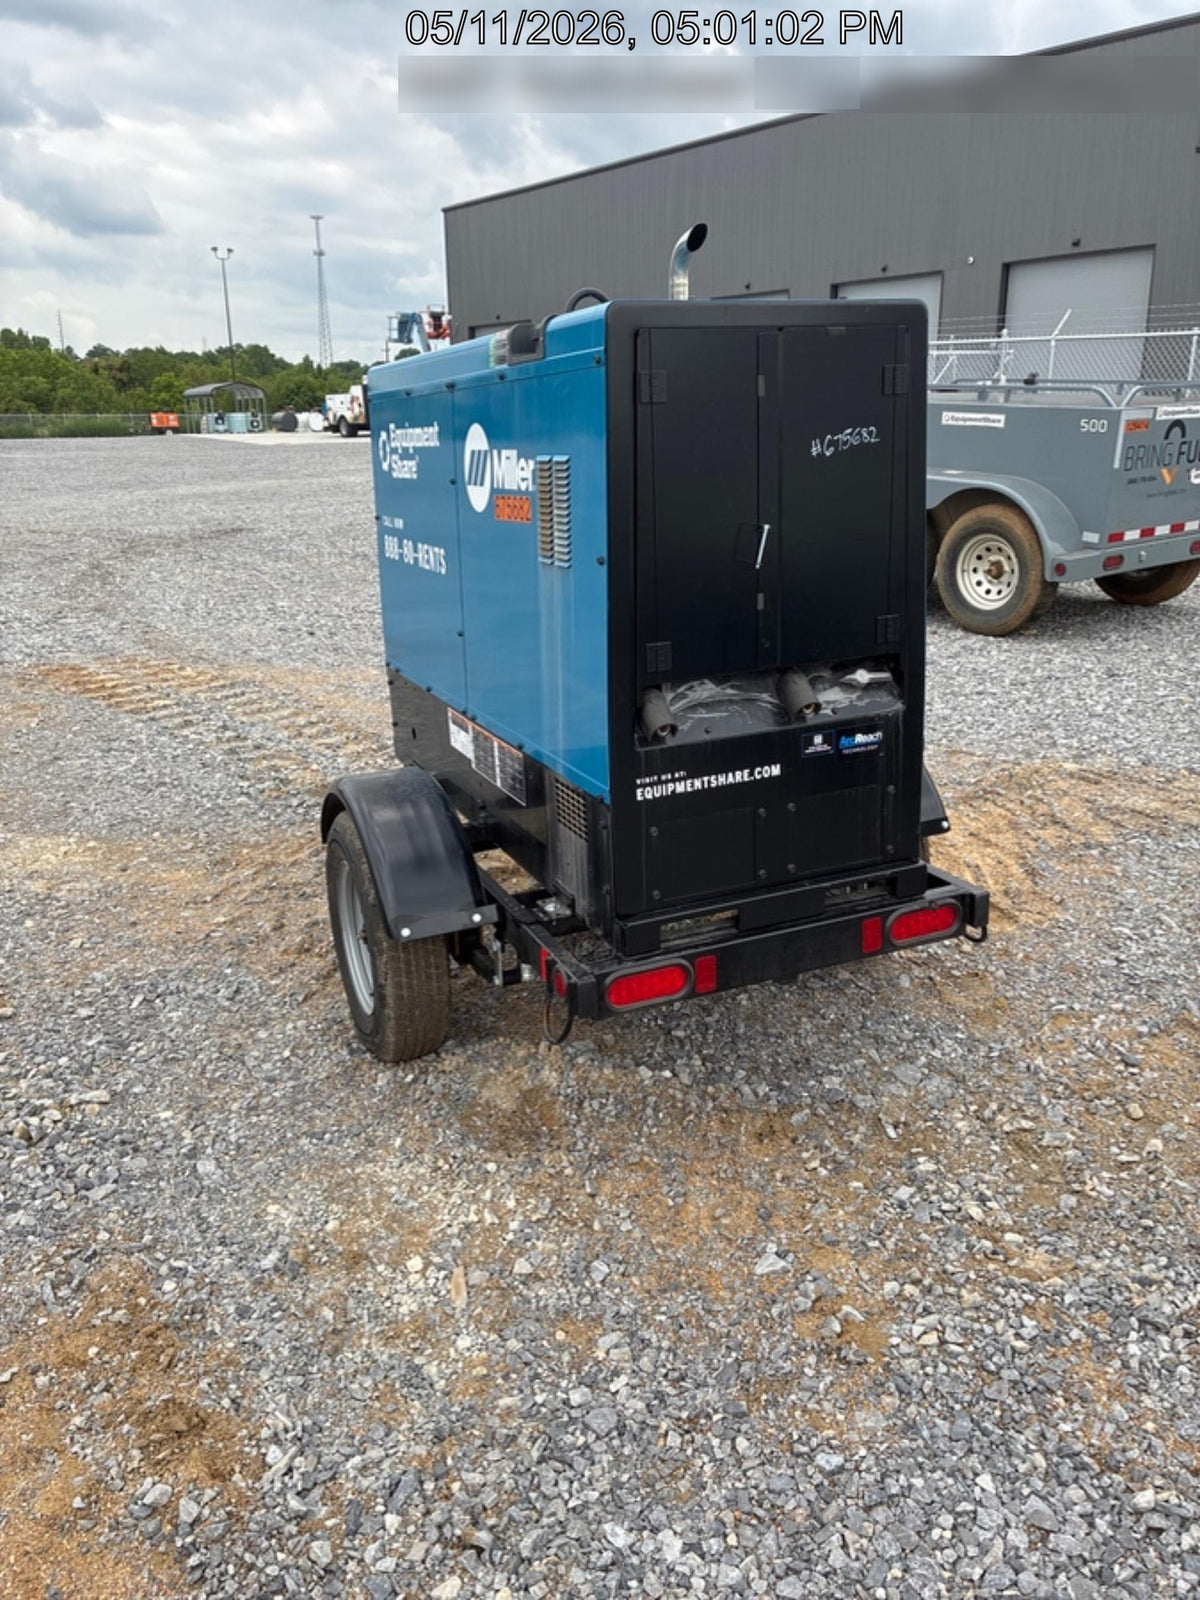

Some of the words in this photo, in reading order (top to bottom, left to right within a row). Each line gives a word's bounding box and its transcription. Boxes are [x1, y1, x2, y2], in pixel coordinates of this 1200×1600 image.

[389, 421, 440, 454] Equipment
[810, 425, 881, 458] #675682
[1079, 418, 1109, 433] 500
[391, 454, 418, 479] Share
[492, 448, 535, 492] Miller
[1124, 441, 1174, 473] BRING
[1175, 439, 1200, 466] FU
[840, 731, 883, 748] ArcReach
[635, 775, 659, 785] VISIT
[661, 773, 672, 781] US
[635, 763, 782, 801] EQUIPMENTSHARE.COM
